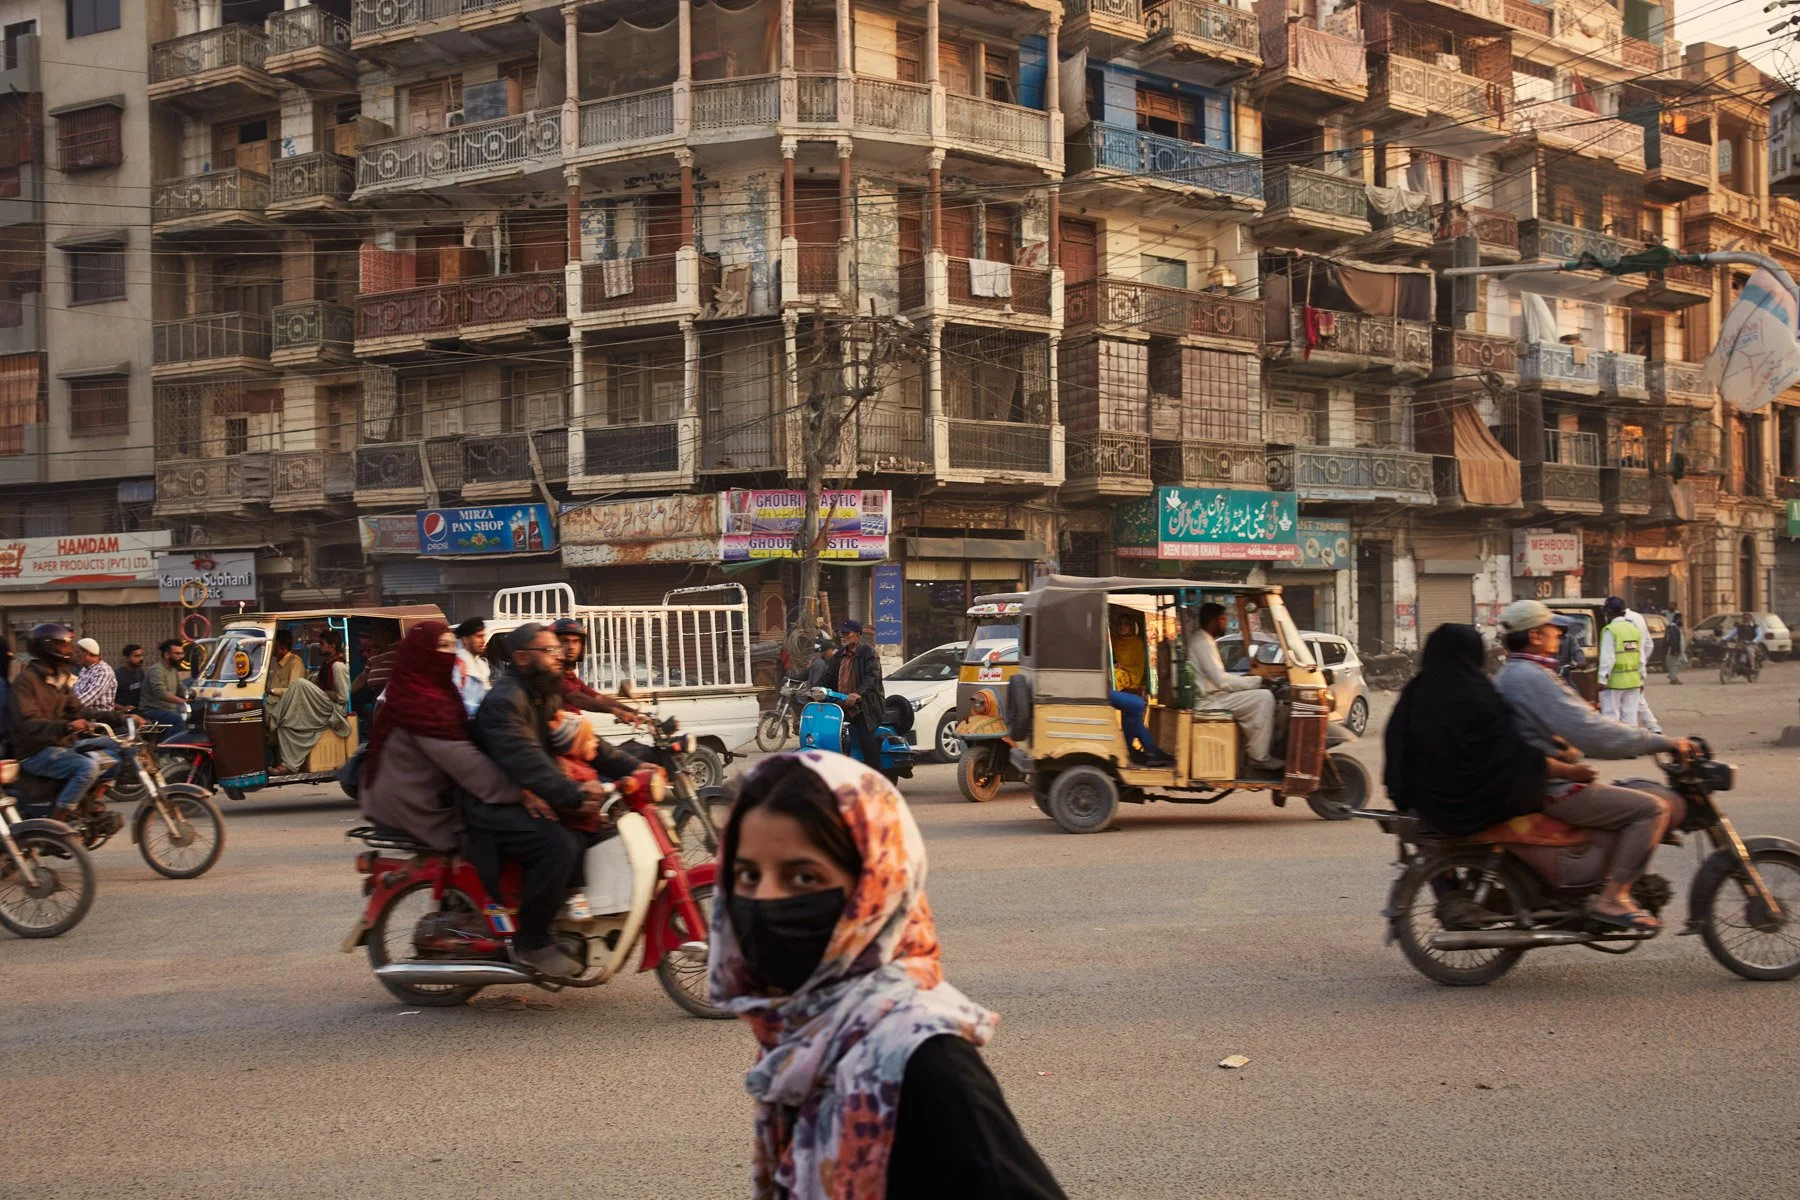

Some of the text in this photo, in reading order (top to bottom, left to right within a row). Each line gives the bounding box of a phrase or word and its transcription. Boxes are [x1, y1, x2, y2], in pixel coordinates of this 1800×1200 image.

[756, 494, 801, 507] GHOURI
[459, 509, 494, 521] MIRZA
[452, 520, 504, 533] PAN SHOP
[57, 536, 120, 555] HAMDAM
[427, 542, 450, 551] pepsi
[750, 539, 793, 549] GHOUR
[829, 539, 859, 549] STIC
[1531, 538, 1575, 550] MEHBOOB
[33, 557, 150, 572] PAPER PRODUCTS (PVT.) LTD.
[1543, 553, 1565, 566] SIGN
[203, 571, 250, 587] Subhani
[1536, 580, 1552, 598] 3D
